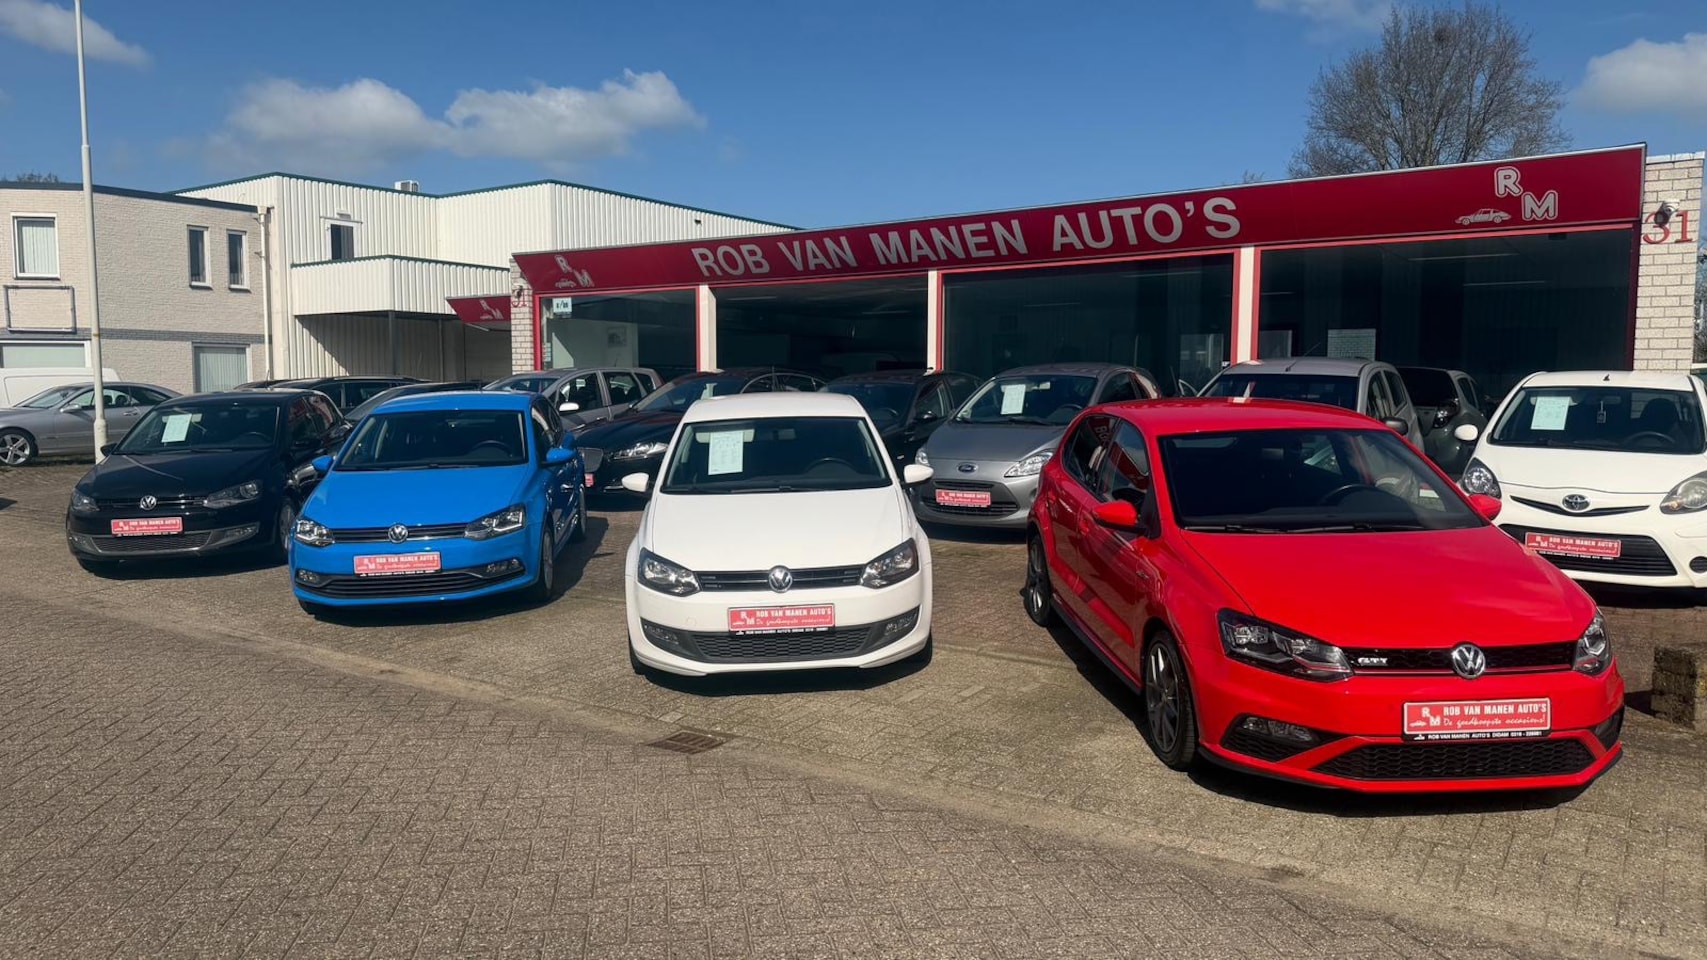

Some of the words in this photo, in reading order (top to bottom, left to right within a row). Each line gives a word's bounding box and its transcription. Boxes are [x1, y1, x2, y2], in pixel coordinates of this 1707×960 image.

[1494, 165, 1523, 198] R
[1521, 189, 1559, 221] M
[691, 244, 770, 277] ROB
[777, 235, 859, 272] VAN
[868, 219, 1028, 265] MANEN
[1052, 197, 1241, 251] AUTO'S
[1642, 210, 1693, 245] 31
[1443, 706, 1460, 716] ROB
[1464, 705, 1481, 715] VAN
[1484, 704, 1514, 715] MANEN
[1517, 703, 1547, 714] AUTO'S
